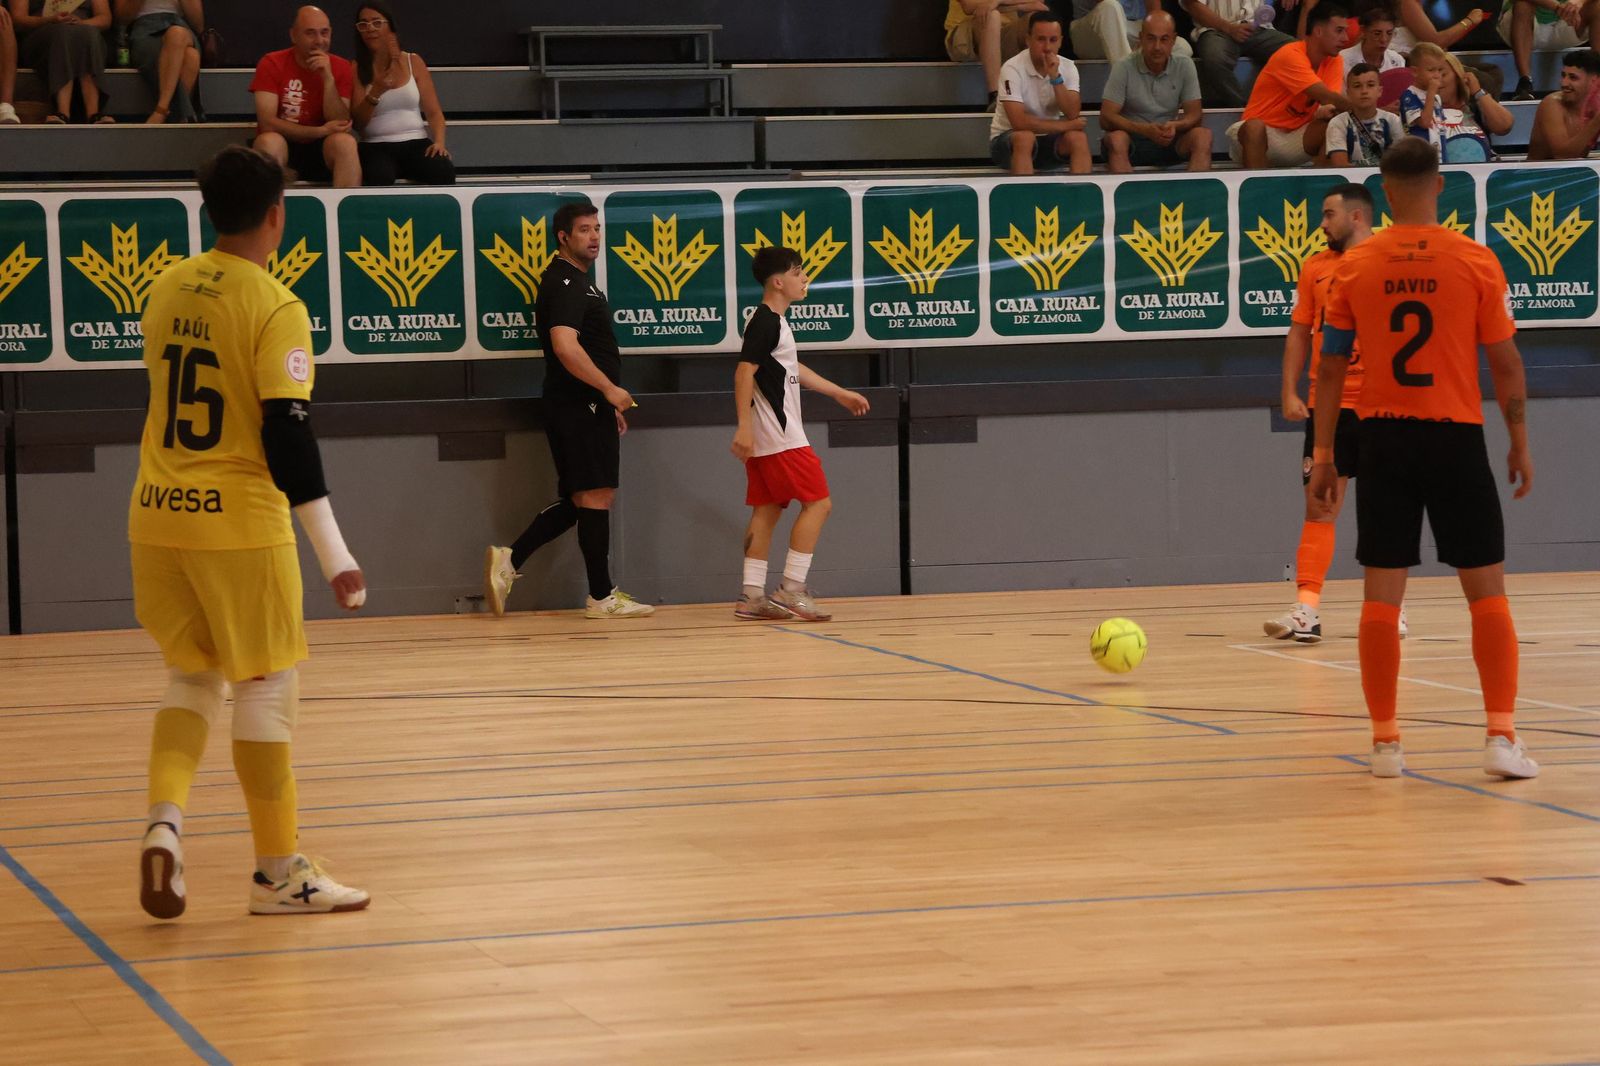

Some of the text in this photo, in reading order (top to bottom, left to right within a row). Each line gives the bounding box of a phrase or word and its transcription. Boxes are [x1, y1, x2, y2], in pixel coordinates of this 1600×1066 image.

[1384, 278, 1439, 295] DAVID
[1536, 281, 1595, 297] RURAL
[995, 296, 1101, 314] CAJA RURAL
[1120, 292, 1225, 310] CAJA RURAL
[1244, 289, 1287, 306] CAJA
[1528, 298, 1576, 310] ZAMORA
[613, 308, 658, 325] CAJA
[661, 307, 722, 323] RURAL
[789, 303, 850, 320] RURAL
[869, 300, 976, 318] CAJA RURAL
[1139, 309, 1207, 321] DE ZAMORA
[1262, 307, 1278, 317] DE
[347, 313, 462, 331] CAJA RURAL
[482, 311, 528, 328] CAJA
[790, 321, 832, 332] AMORA
[888, 317, 957, 329] DE ZAMORA
[1014, 313, 1082, 325] DE ZAMORA
[69, 321, 119, 338] CAJA
[172, 317, 211, 342] RAÚL
[368, 331, 442, 343] DE ZAMORA
[502, 329, 519, 340] DE
[632, 324, 704, 337] DE ZAMORA
[91, 340, 110, 350] DE
[1390, 300, 1434, 387] 2
[162, 344, 225, 451] 15
[140, 483, 224, 514] uvesa
